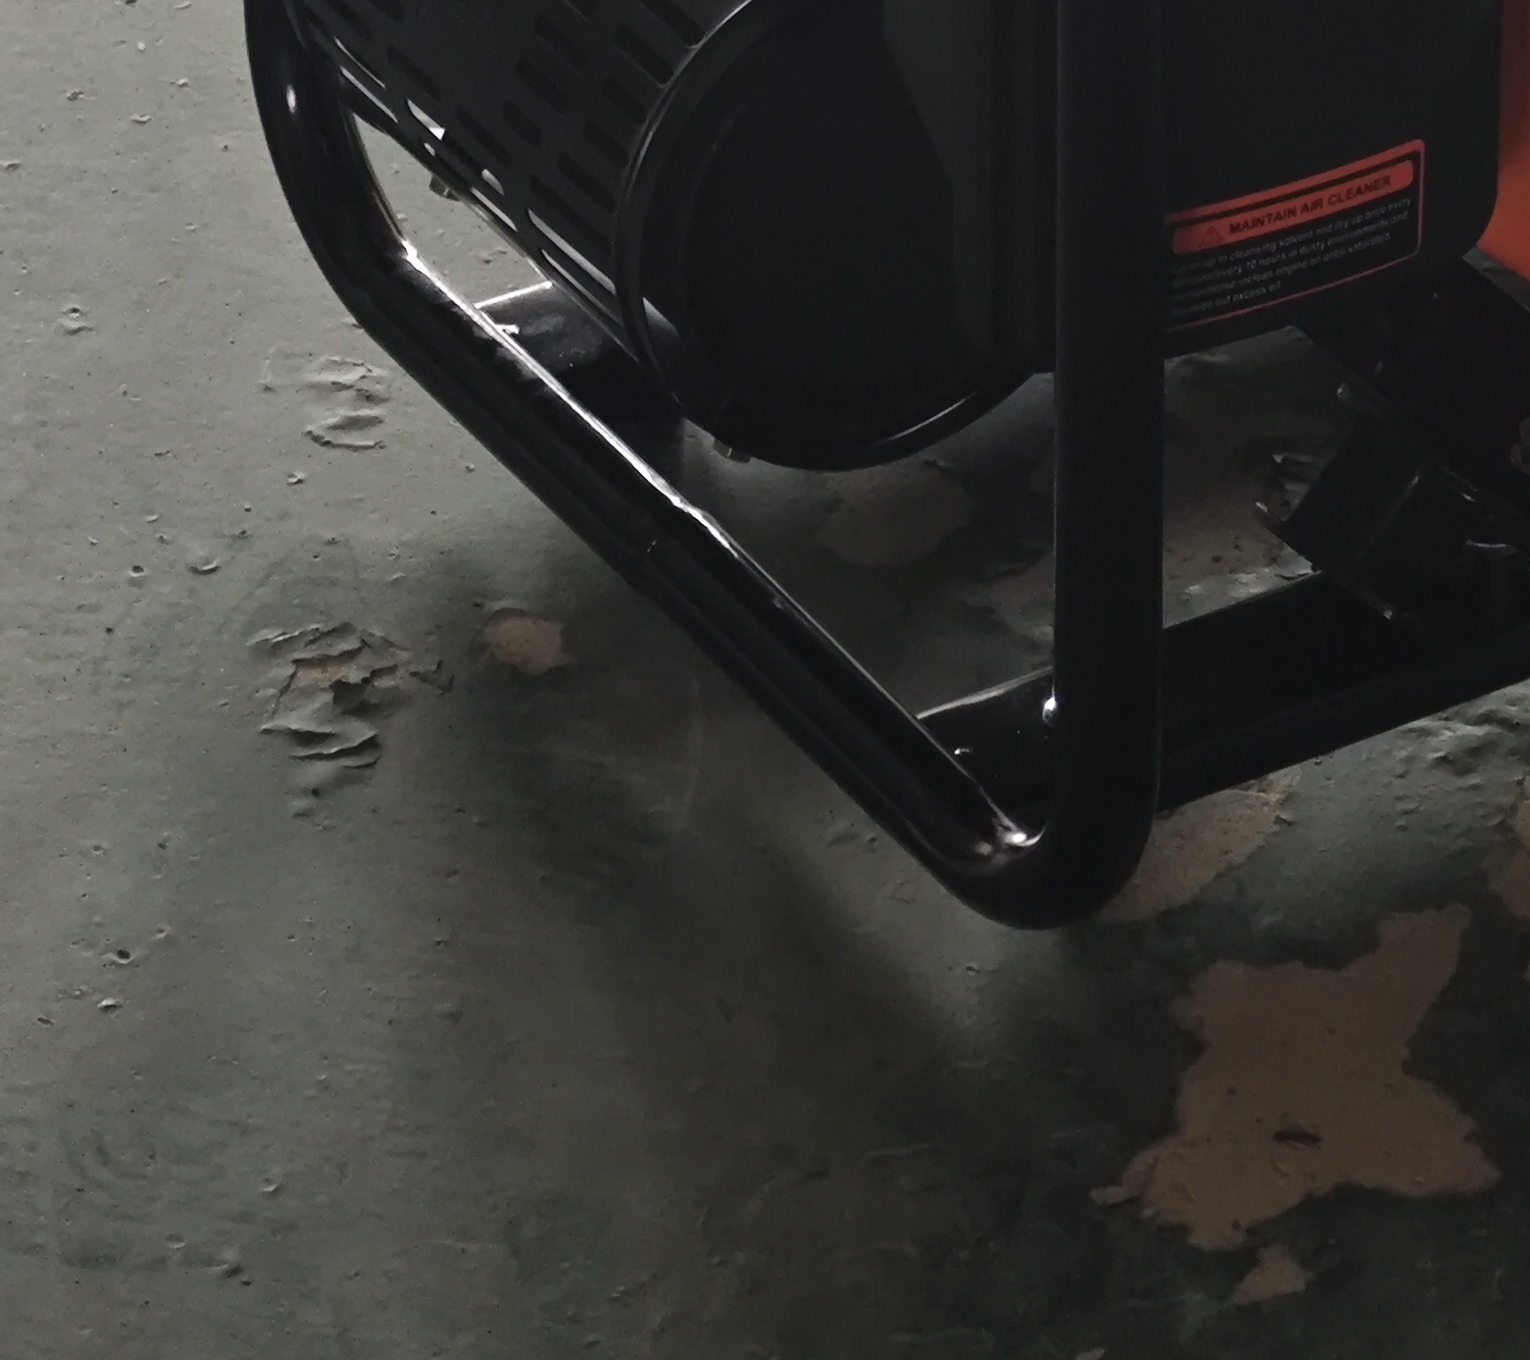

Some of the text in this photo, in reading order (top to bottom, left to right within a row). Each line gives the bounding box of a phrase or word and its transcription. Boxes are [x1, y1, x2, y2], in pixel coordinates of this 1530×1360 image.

[1229, 175, 1391, 234] MAINTAIN AIR CLEANER
